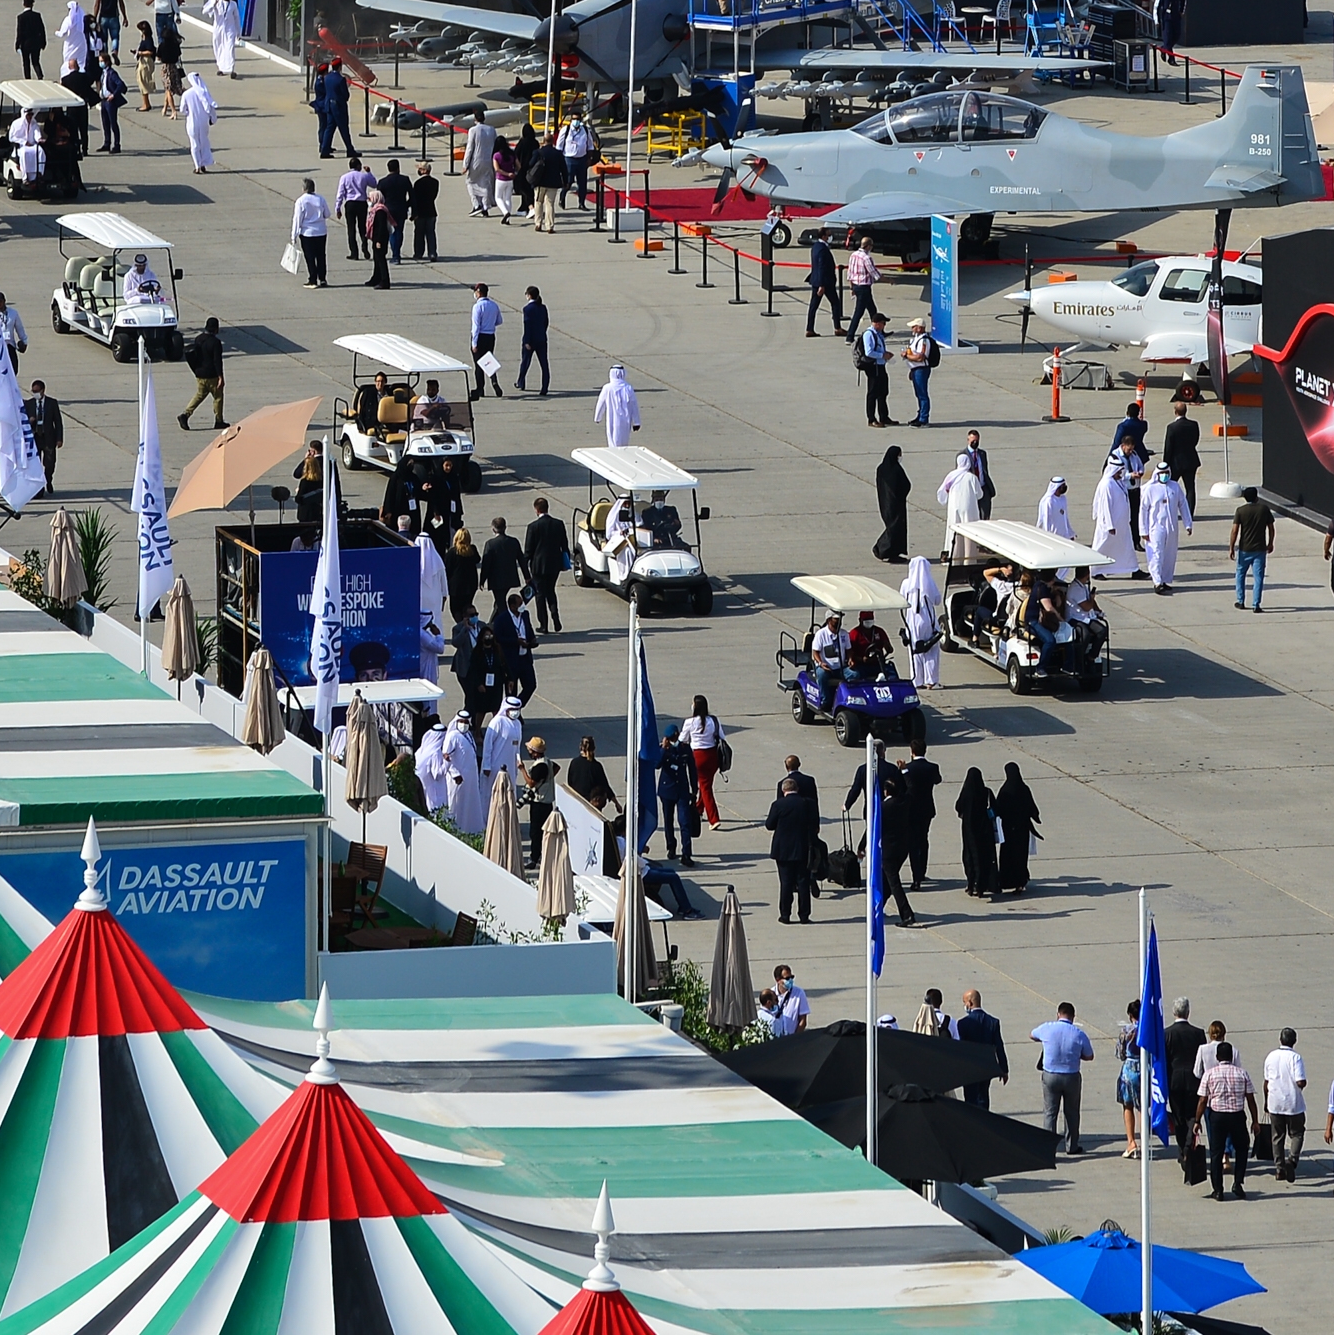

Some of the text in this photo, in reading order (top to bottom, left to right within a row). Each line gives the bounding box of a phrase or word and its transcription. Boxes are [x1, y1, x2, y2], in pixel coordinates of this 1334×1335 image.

[1250, 134, 1271, 145] 981
[1249, 147, 1272, 156] B-250
[990, 185, 1042, 195] EXPERIMENTAL
[1052, 301, 1115, 317] Emirates
[1295, 366, 1331, 397] PLANET
[346, 574, 372, 591] HIGH
[341, 591, 385, 609] ESPOKE
[117, 859, 281, 891] DASSAULT
[115, 887, 266, 916] AVIATION
